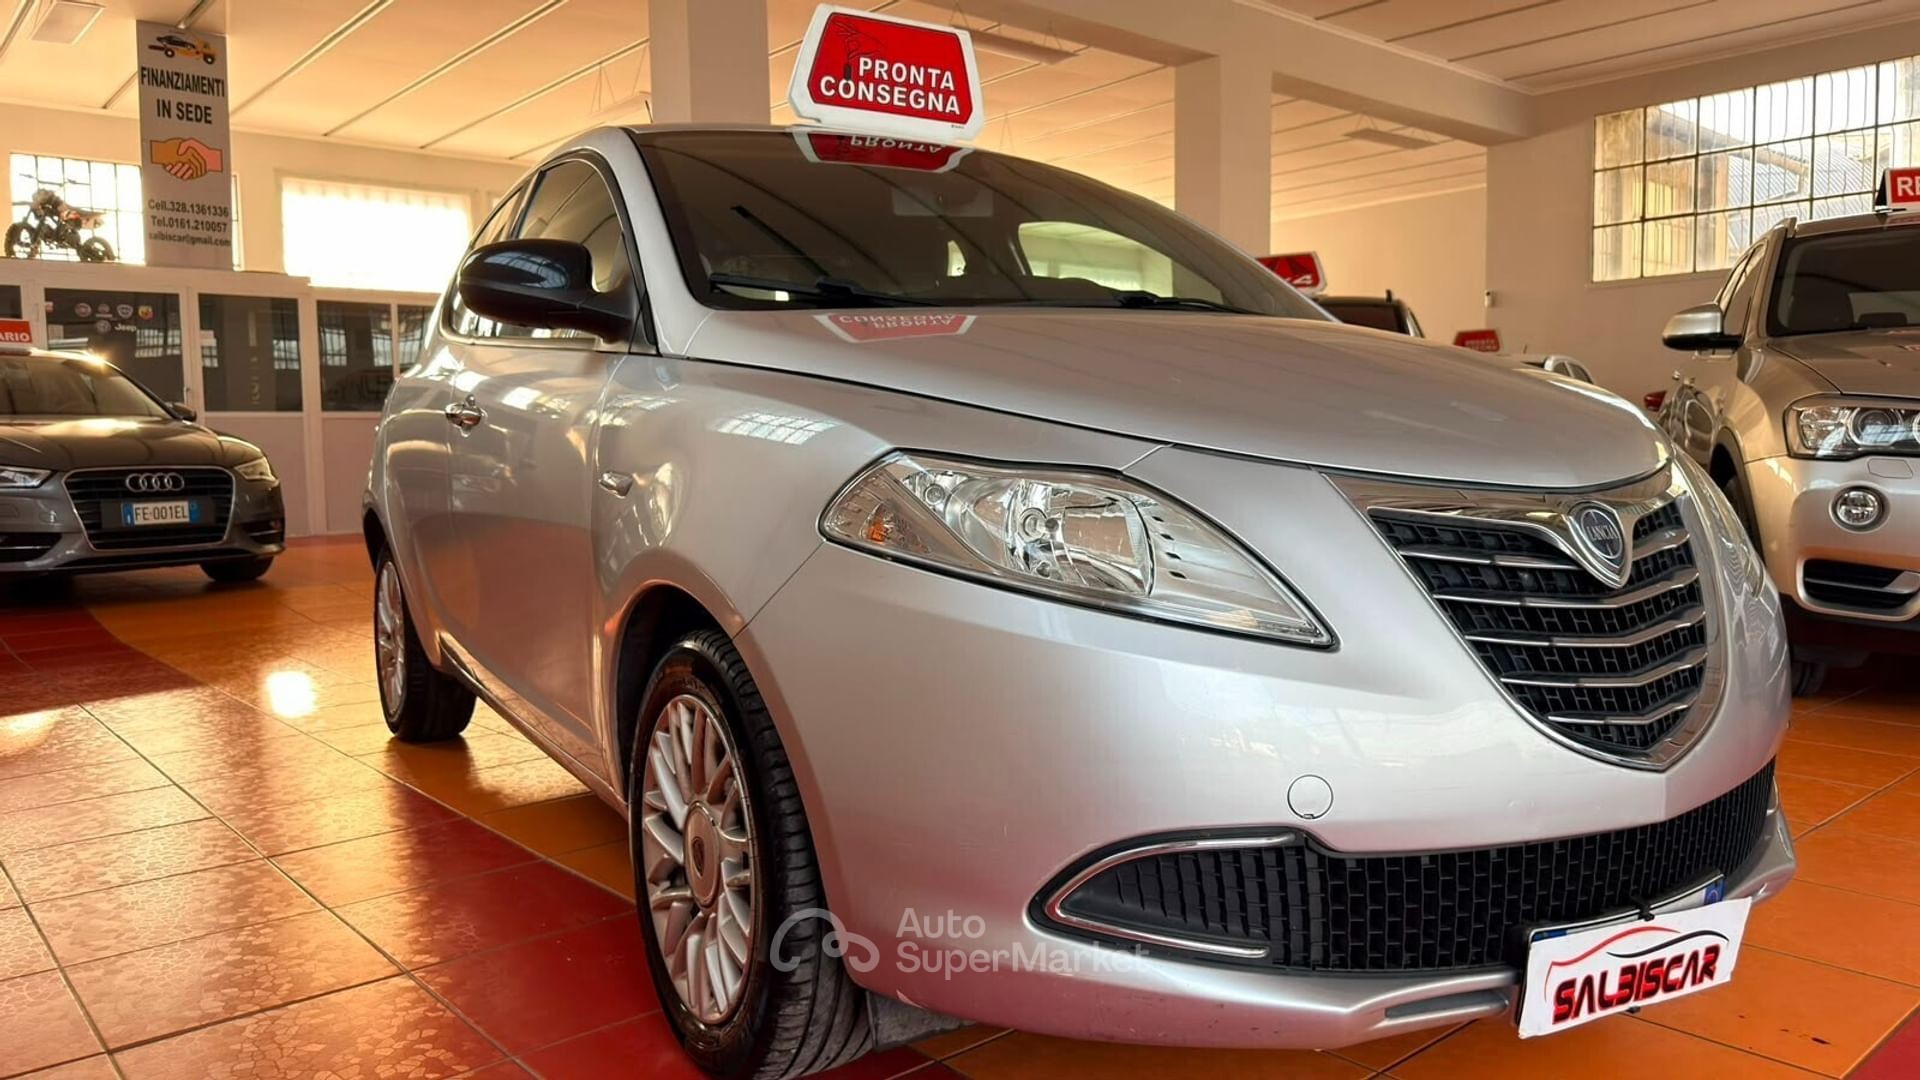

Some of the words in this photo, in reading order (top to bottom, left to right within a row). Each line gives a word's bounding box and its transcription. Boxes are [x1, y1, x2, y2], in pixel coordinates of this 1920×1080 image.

[141, 66, 225, 98] FINANZIAMENTI
[858, 57, 956, 91] PRONTA
[156, 98, 172, 119] IN
[175, 101, 213, 125] SEDE
[819, 75, 961, 115] CONSEGNA
[1552, 943, 1721, 1025] SALBISCAR
